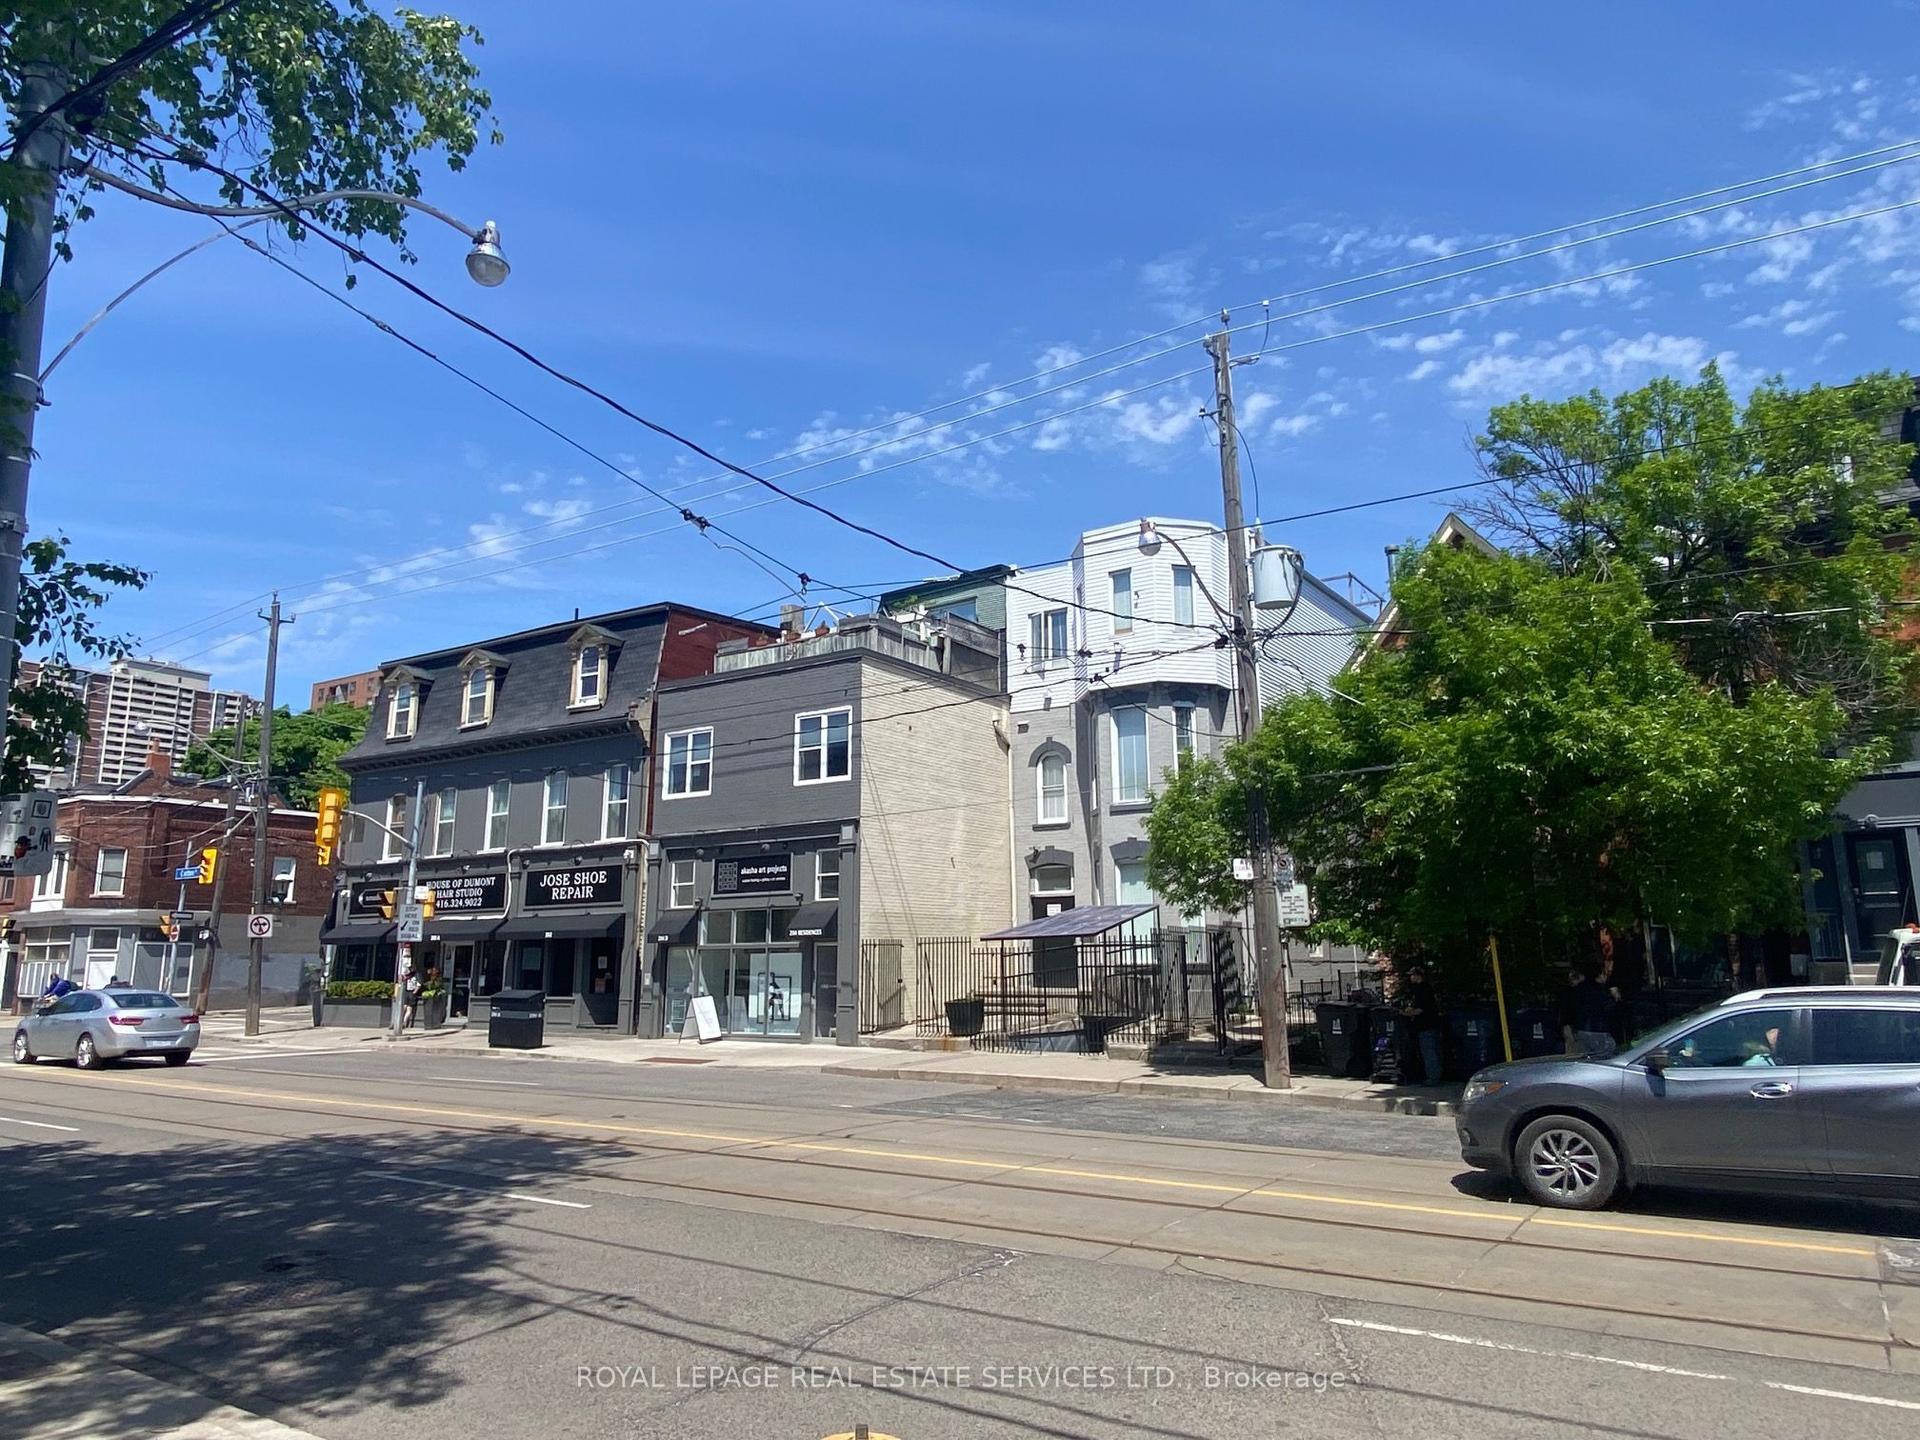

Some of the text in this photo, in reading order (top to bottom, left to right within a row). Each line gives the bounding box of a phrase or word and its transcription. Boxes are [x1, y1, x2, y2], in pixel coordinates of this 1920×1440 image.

[426, 877, 496, 889] HOUSE OF DUMONT
[540, 871, 607, 887] JOSE SHOE
[436, 888, 483, 899] HAIR STUDIO
[551, 886, 594, 900] REPAIR
[436, 898, 483, 909] 416.324.9022
